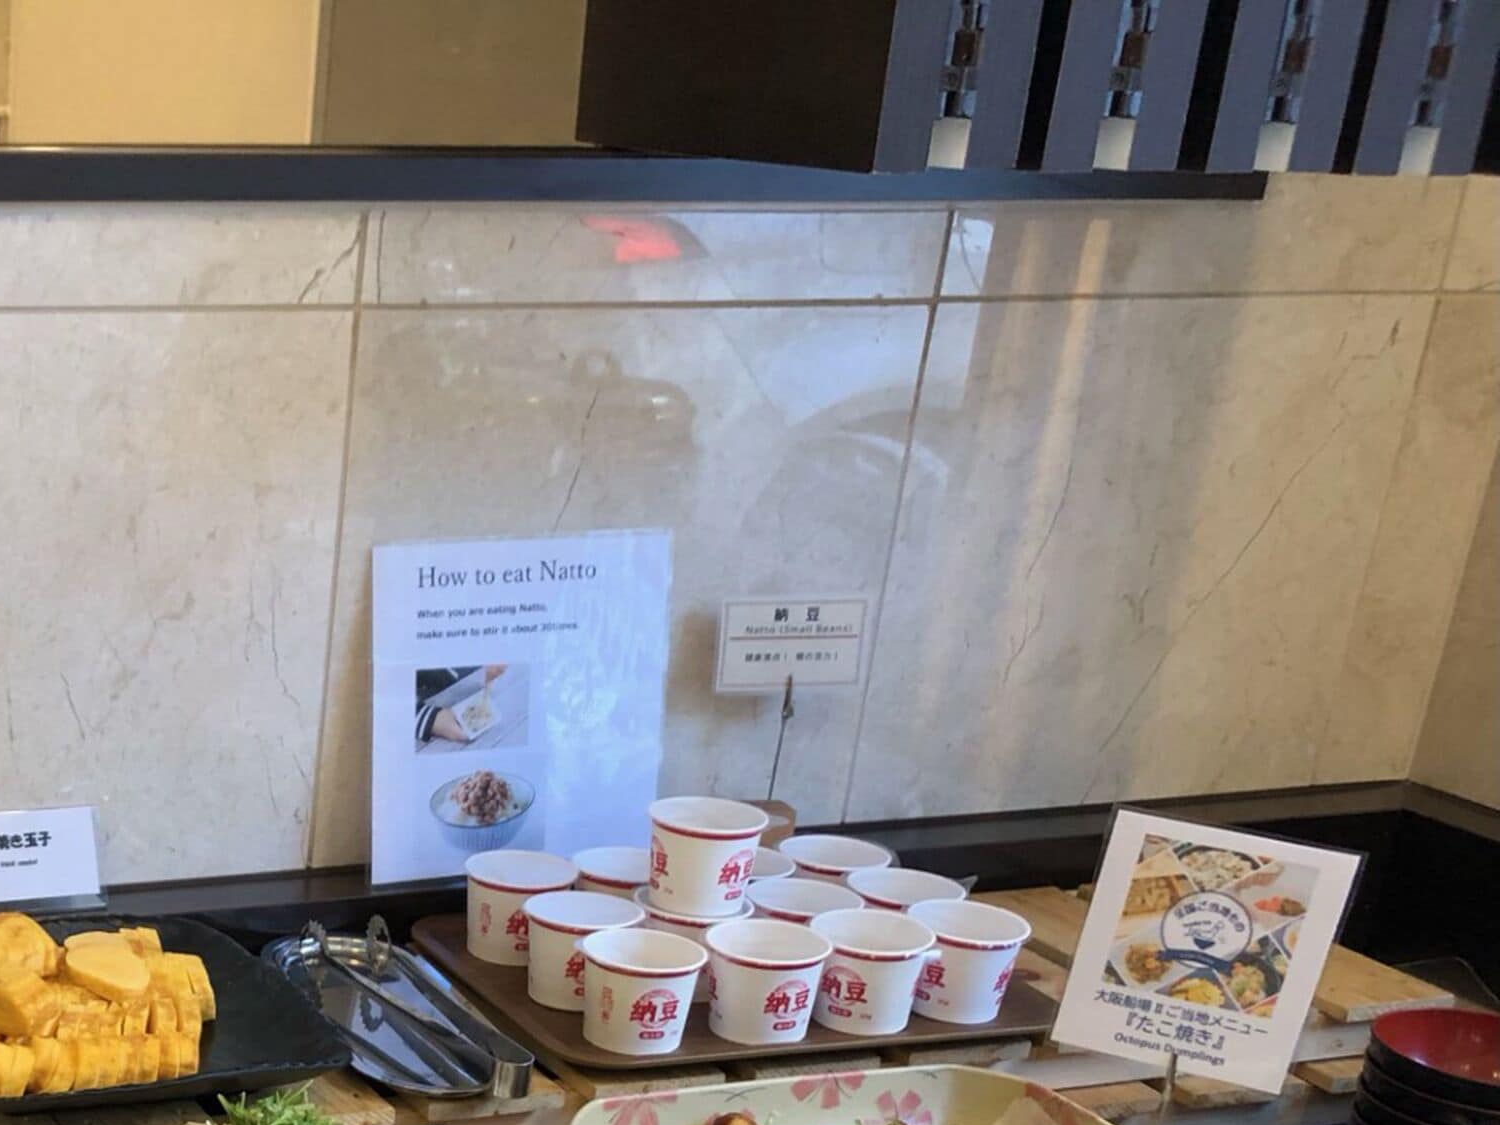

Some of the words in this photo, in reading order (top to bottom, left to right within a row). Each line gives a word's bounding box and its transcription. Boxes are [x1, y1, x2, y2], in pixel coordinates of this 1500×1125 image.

[418, 566, 467, 588] How
[475, 568, 495, 585] to
[502, 566, 532, 583] eat
[539, 560, 597, 581] Natto
[417, 609, 445, 619] When
[448, 608, 466, 619] you
[468, 607, 484, 616] are
[487, 604, 517, 616] eating
[416, 630, 443, 640] make
[446, 628, 467, 638] sure
[470, 627, 480, 637] to
[483, 626, 500, 636] stir
[511, 624, 538, 634] about
[745, 625, 776, 635] Natto
[779, 625, 813, 635] (Small
[821, 974, 868, 1003] 納豆
[629, 1000, 679, 1022] 納豆
[764, 988, 810, 1014] 納豆
[1114, 1032, 1161, 1052] Octopus
[1164, 1042, 1225, 1066] Dumplings
